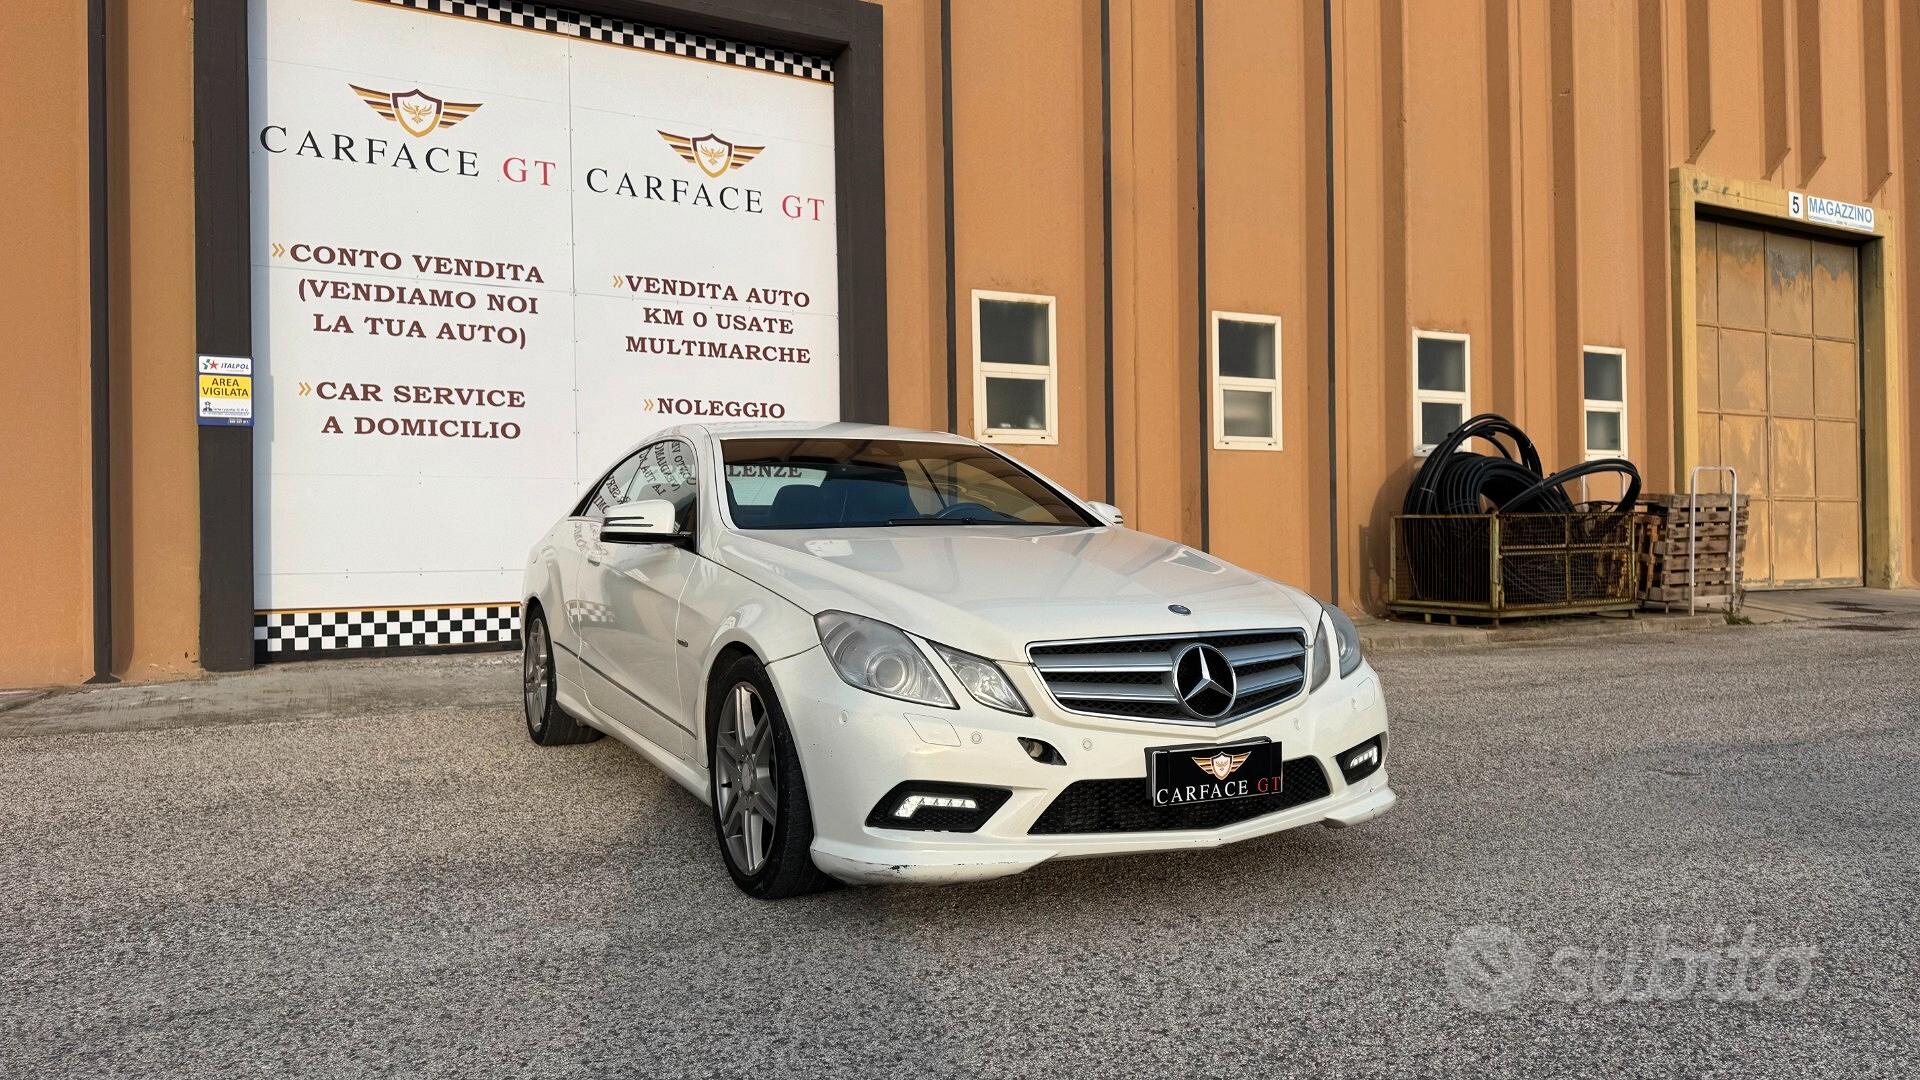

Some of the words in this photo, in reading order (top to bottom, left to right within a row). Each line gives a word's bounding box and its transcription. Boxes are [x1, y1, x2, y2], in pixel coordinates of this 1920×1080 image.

[259, 125, 480, 177] CARFACE
[502, 157, 556, 186] GT
[586, 168, 763, 214] CARFACE
[782, 195, 825, 221] GT
[1792, 196, 1800, 214] 5
[1809, 198, 1872, 223] MAGAZZINO
[290, 244, 402, 271] CONTO
[412, 254, 545, 284] VENDITA
[298, 278, 477, 309] (VENDIAMO
[487, 293, 539, 314] NOI
[626, 275, 738, 301] VENDITA
[746, 288, 811, 308] AUTO
[313, 313, 354, 334] LA
[364, 316, 427, 339] TUA
[436, 322, 527, 350] AUTO)
[643, 307, 684, 326] KM
[716, 313, 794, 334] USATE
[625, 335, 811, 364] MULTIMARCHE
[220, 362, 250, 370] ITALPOL
[202, 387, 249, 397] VIGILATA
[211, 378, 240, 387] AREA
[315, 381, 383, 402] CAR
[393, 385, 527, 408] SERVICE
[657, 398, 786, 418] NOLEGGIO
[321, 416, 344, 435] A
[354, 417, 522, 440] DOMICILIO
[1156, 780, 1249, 804] CARFACE
[1257, 776, 1281, 793] GT
